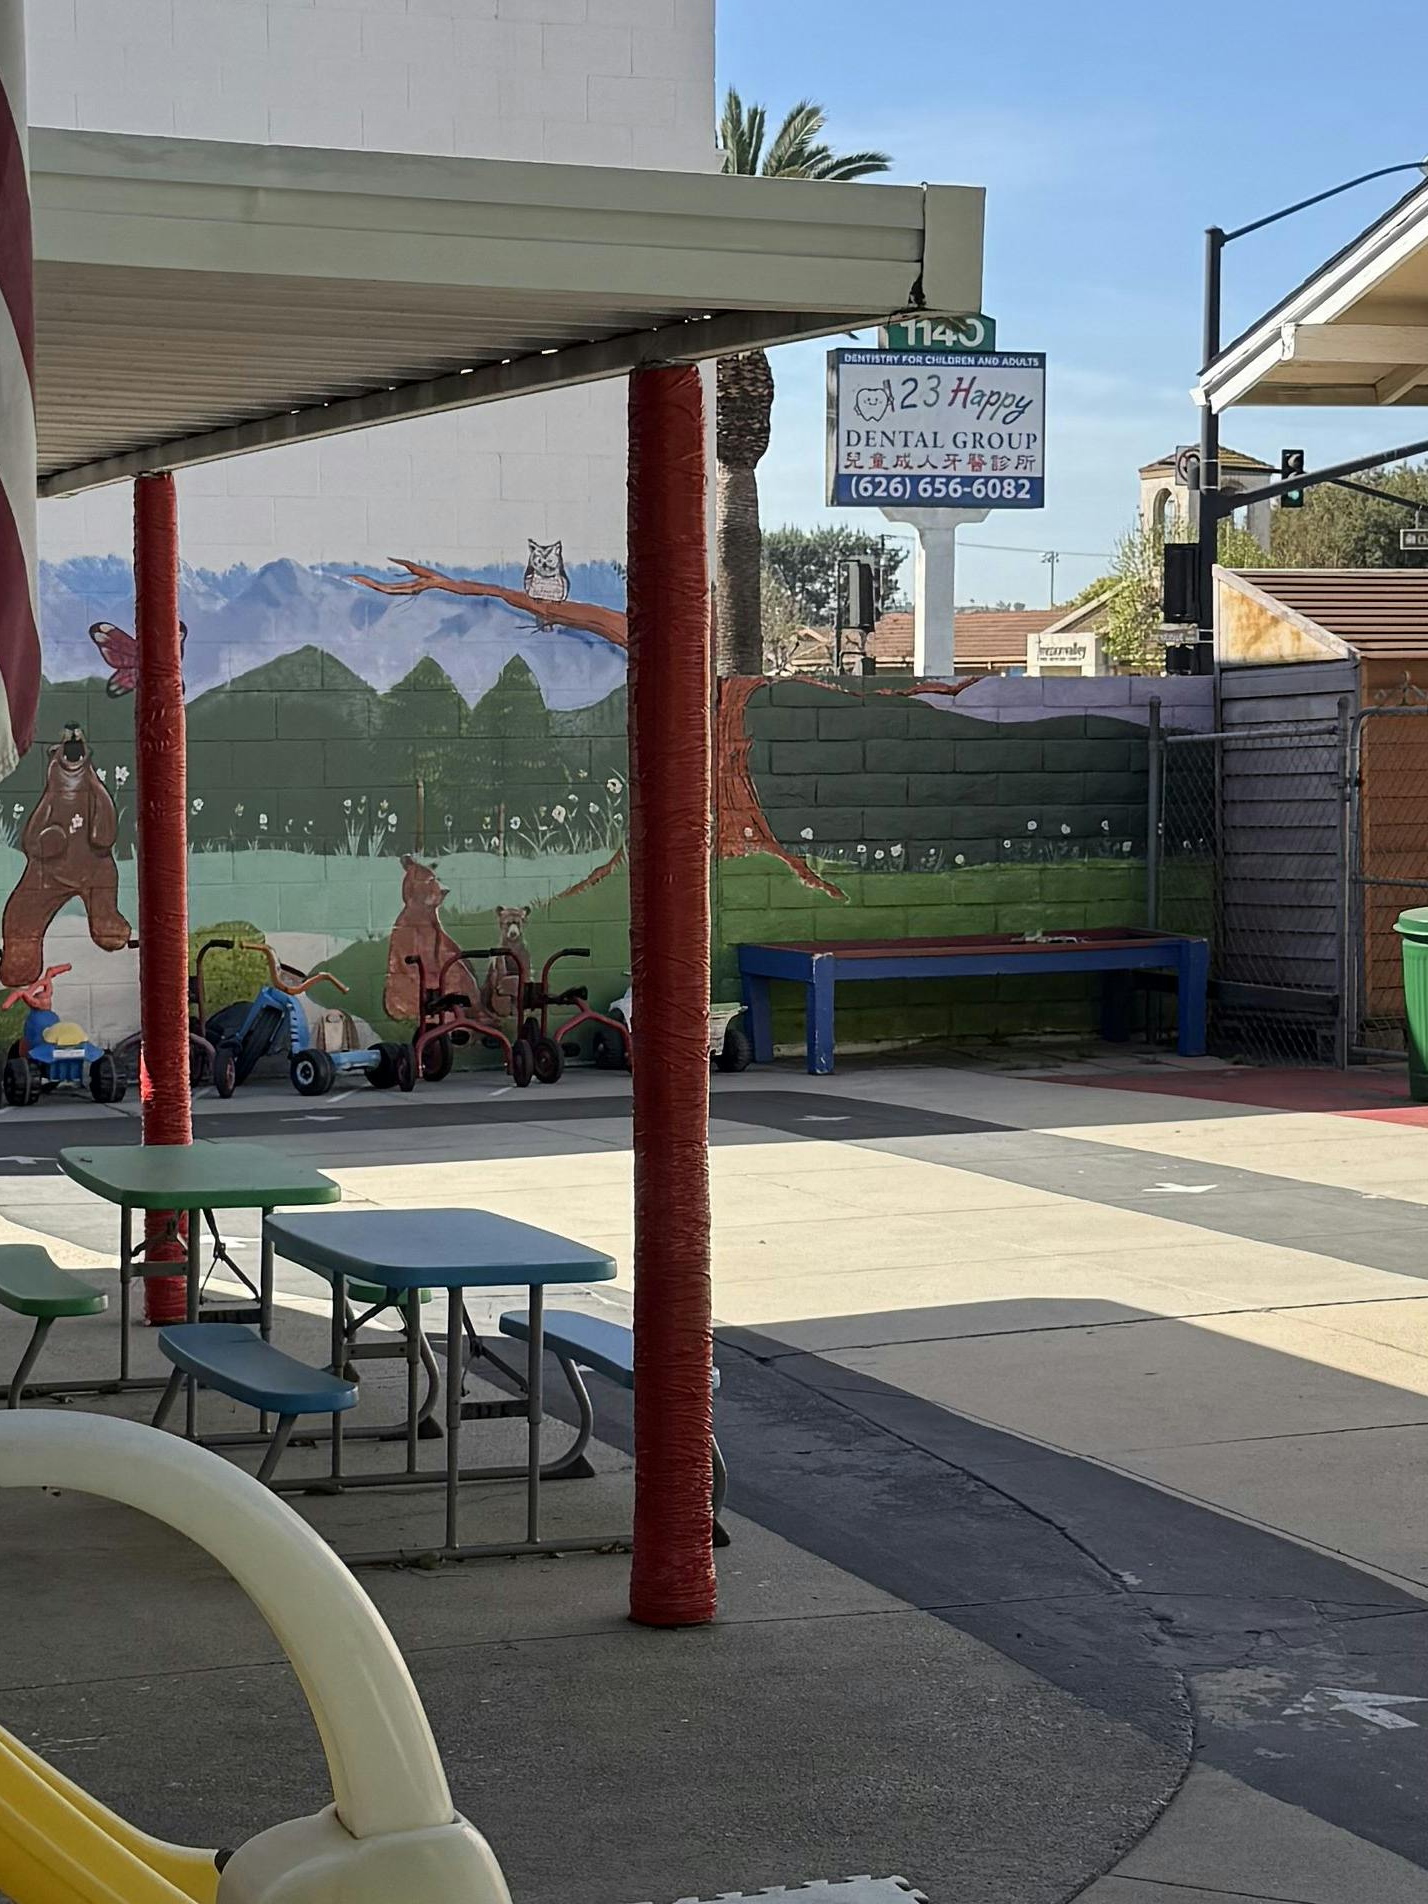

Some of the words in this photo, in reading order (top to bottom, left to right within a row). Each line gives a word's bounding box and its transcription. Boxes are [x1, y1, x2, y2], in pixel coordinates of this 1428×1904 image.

[900, 318, 985, 348] 1140
[844, 353, 900, 364] DENTISTRY
[902, 354, 922, 364] FOR
[925, 355, 975, 366] CHILDREN
[977, 356, 999, 366] AND
[1002, 357, 1039, 367] ADULTS
[947, 376, 1034, 425] Happy
[845, 429, 945, 449] DENTAL
[952, 431, 1038, 450] GROUP
[843, 451, 1037, 473] 兒童成人牙醫診所
[850, 475, 911, 500] (626)
[917, 476, 1031, 499] 656-6082
